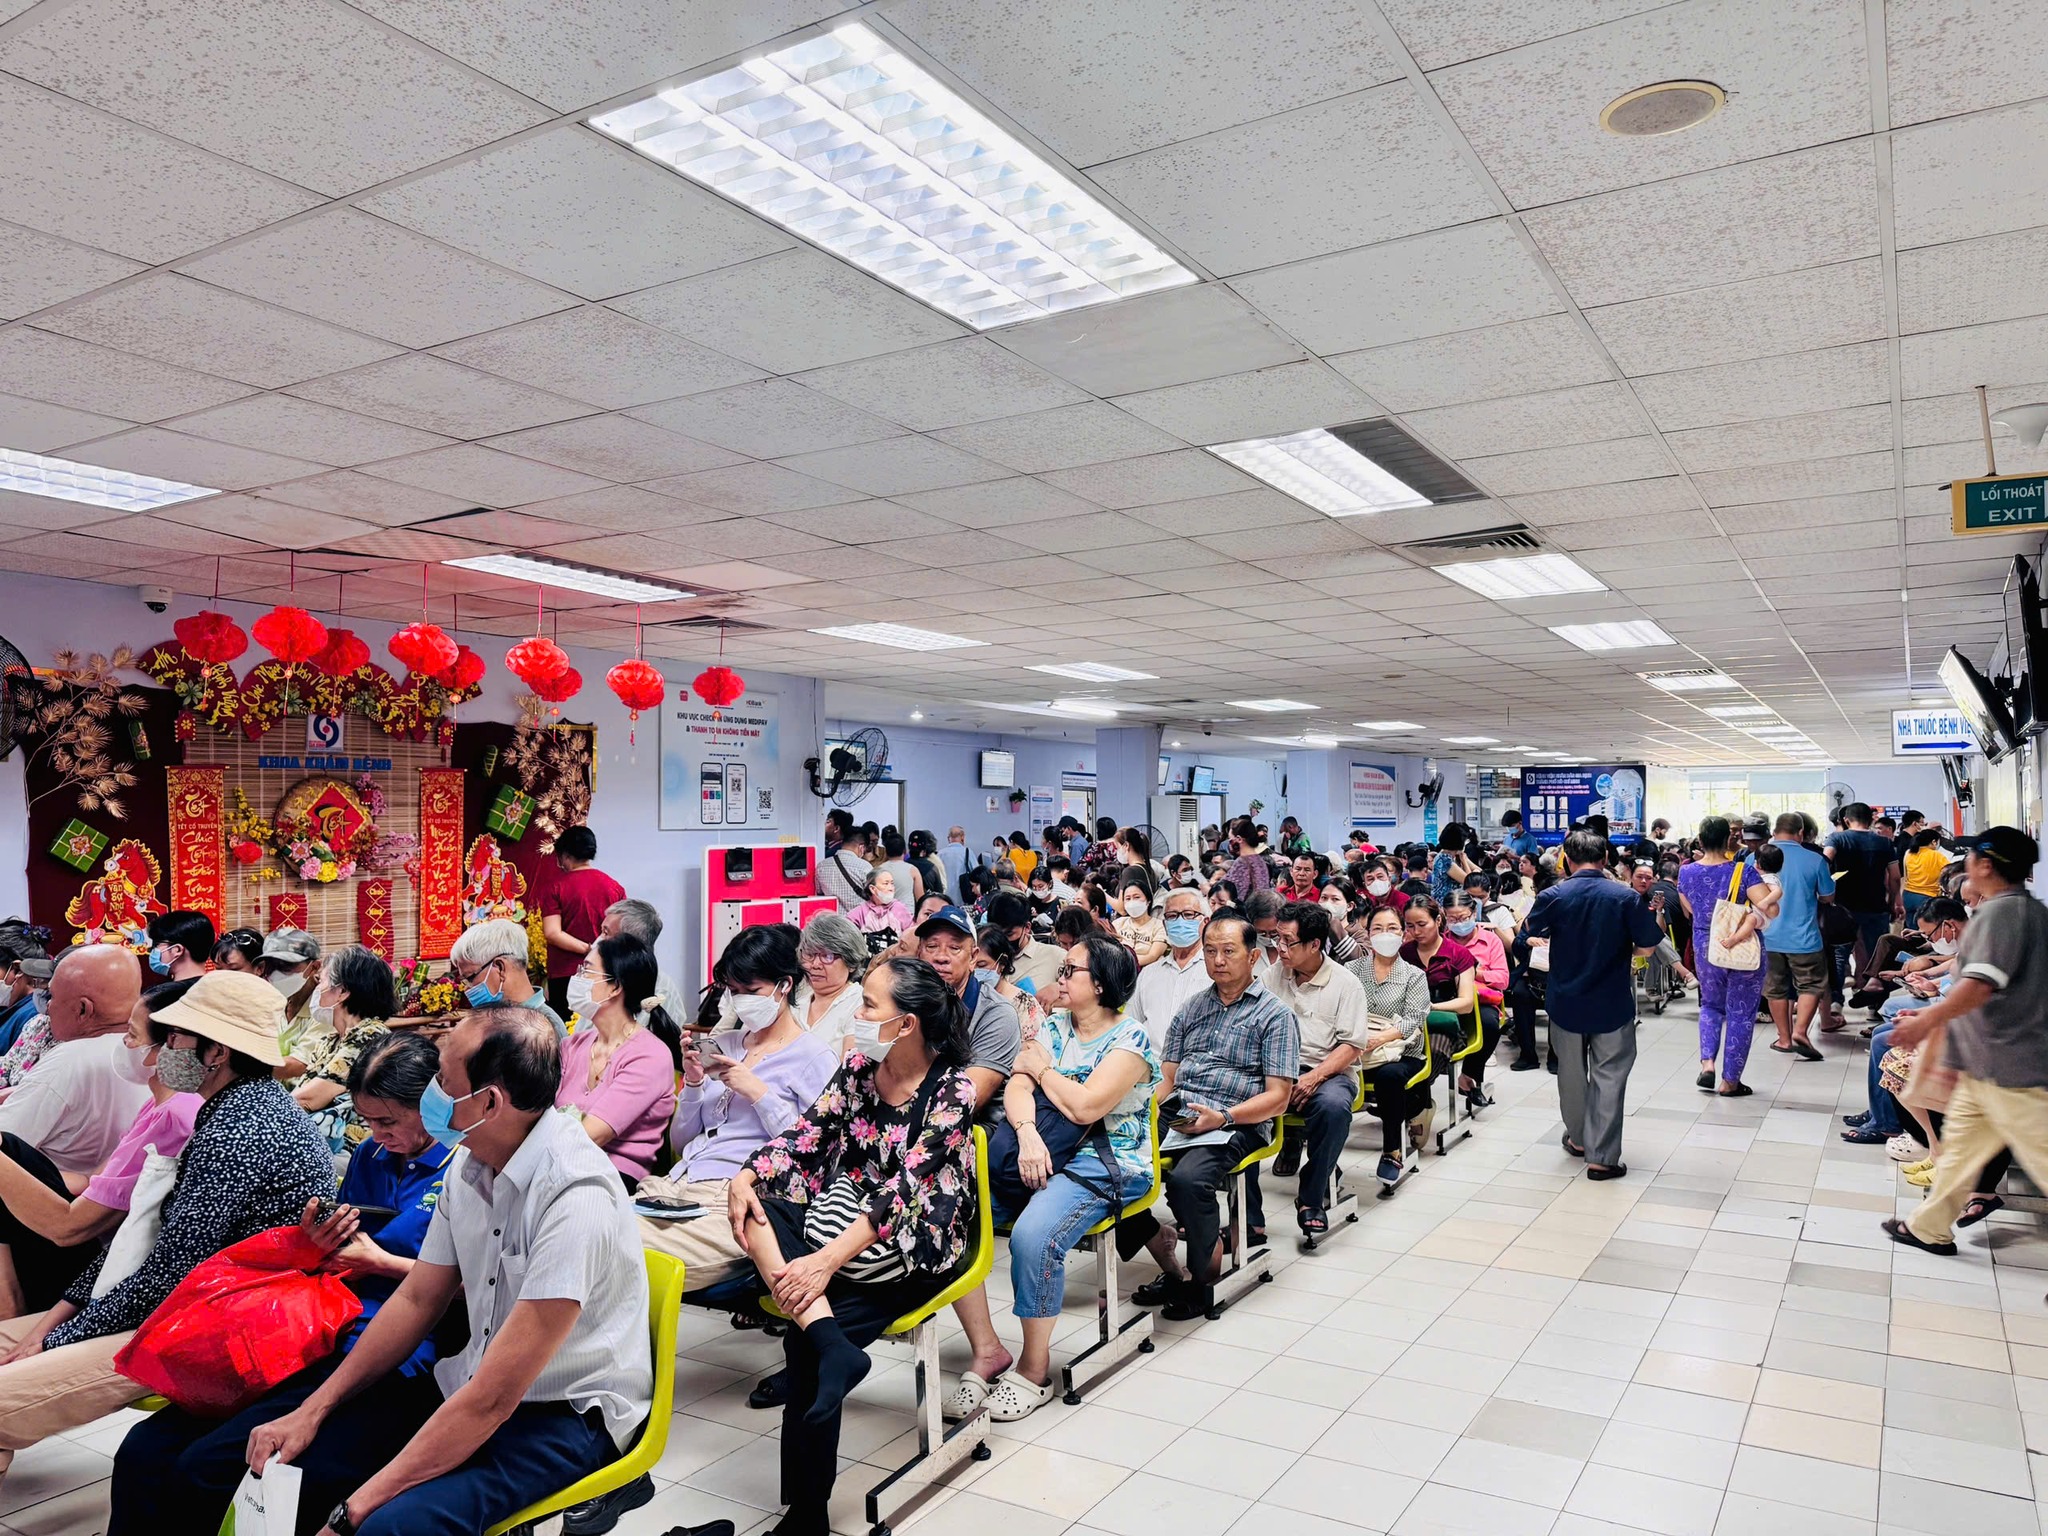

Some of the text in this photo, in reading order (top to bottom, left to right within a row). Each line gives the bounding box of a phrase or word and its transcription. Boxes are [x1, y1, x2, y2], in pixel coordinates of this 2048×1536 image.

[1981, 483, 2043, 501] LỐI THOÁT
[1988, 507, 2037, 522] EXIT
[677, 712, 688, 720] KHU
[689, 712, 699, 721] VỰC
[691, 725, 708, 733] THANH
[722, 727, 739, 736] KHÔNG
[1897, 713, 1912, 736] NHÀ
[1913, 711, 1937, 736] THUỐC
[1939, 713, 1958, 738] BỆNH
[258, 756, 300, 769] KHOA
[305, 754, 350, 770] KHÁM
